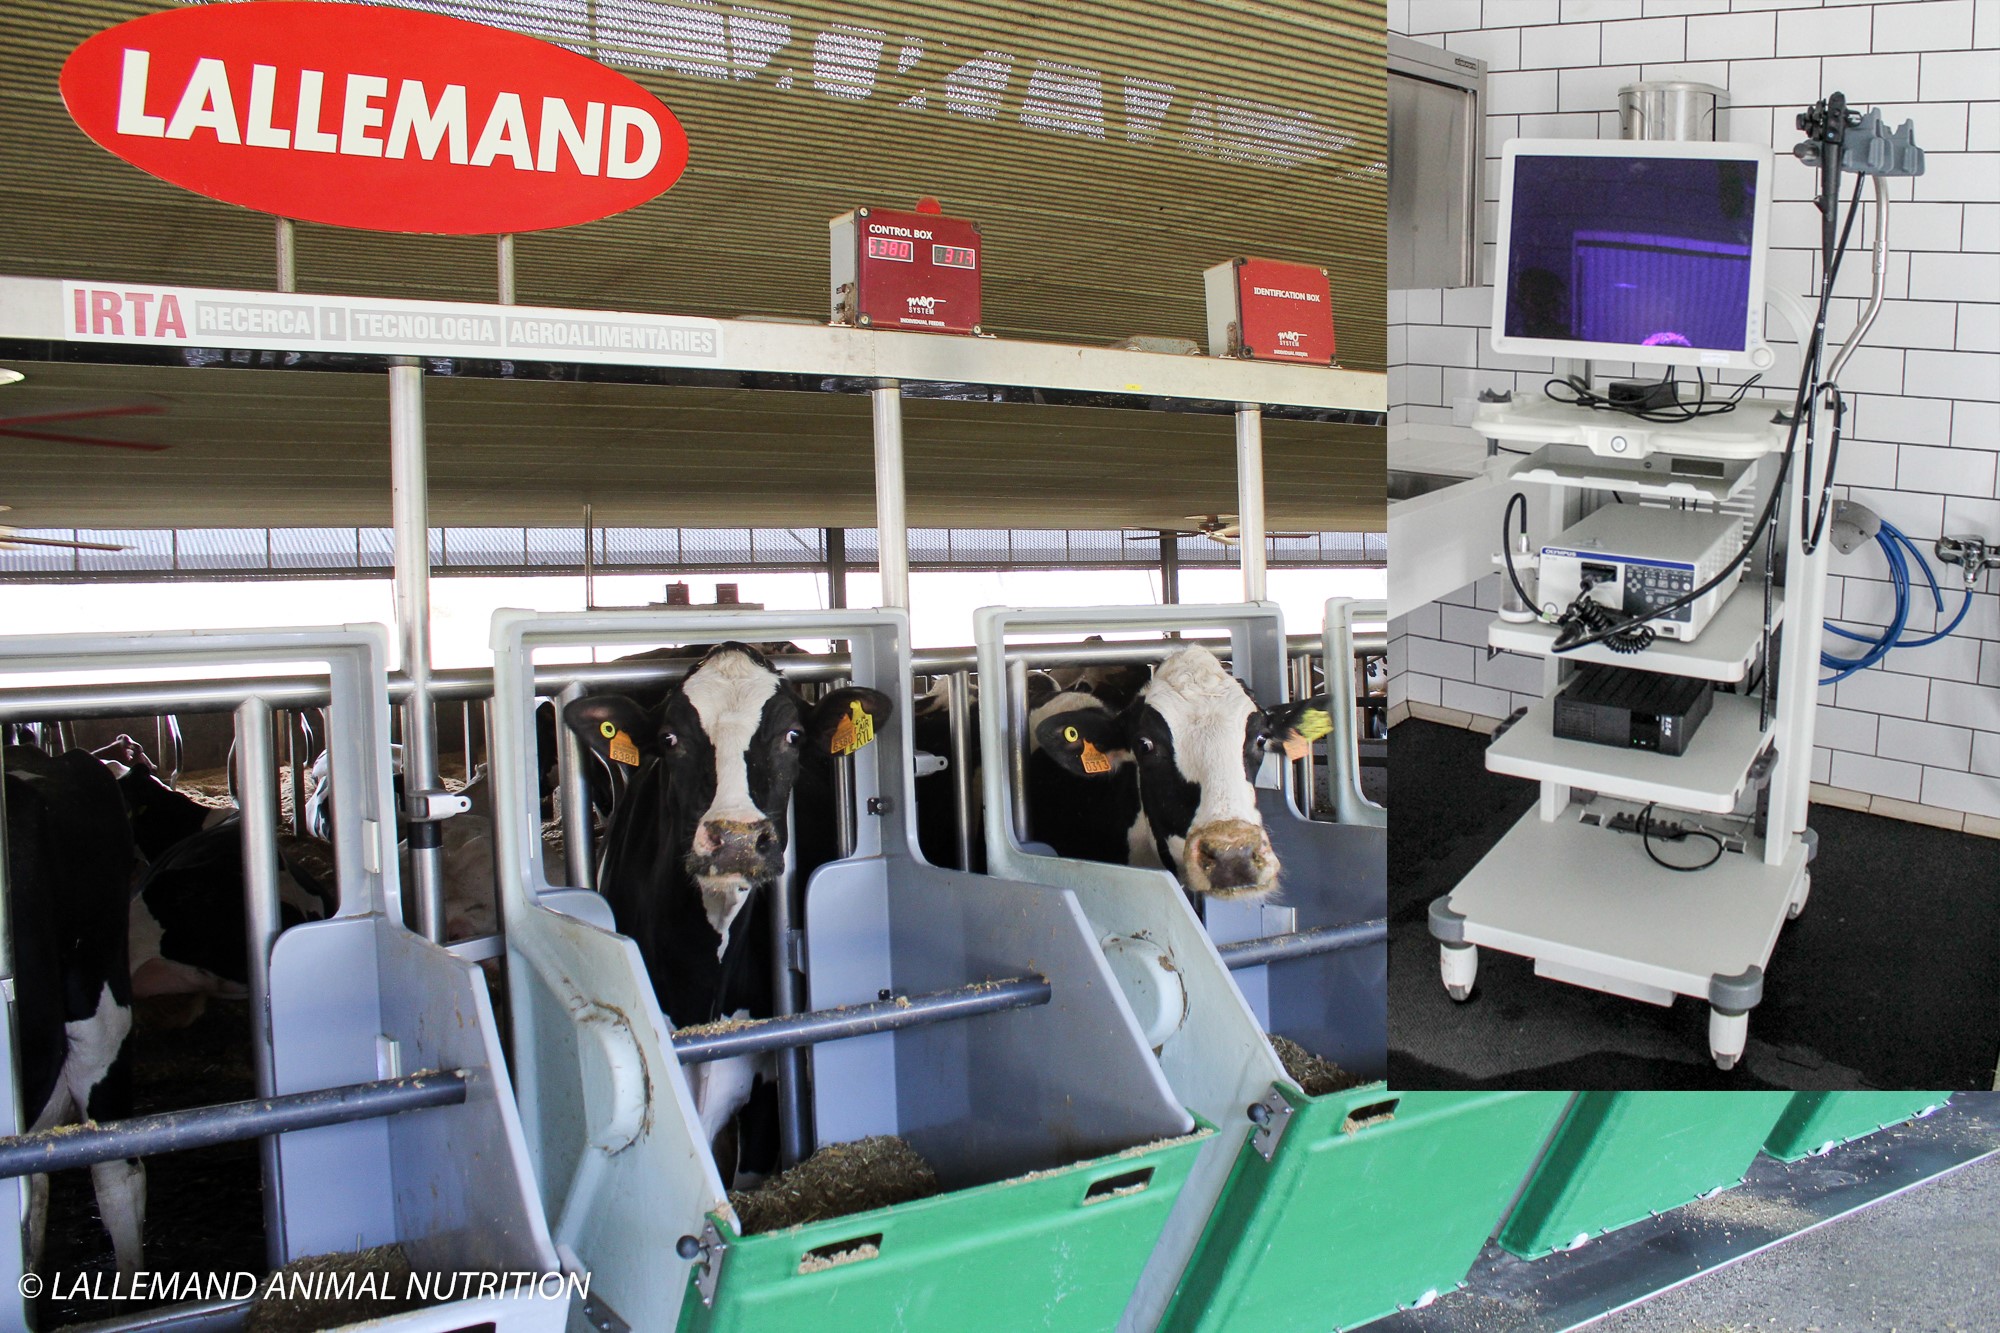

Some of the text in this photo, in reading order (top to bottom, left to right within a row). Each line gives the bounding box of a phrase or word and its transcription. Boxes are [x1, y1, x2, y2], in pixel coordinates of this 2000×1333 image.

[116, 47, 662, 181] LALLEMAND
[868, 223, 933, 241] CONTROL BOX
[1253, 286, 1321, 302] IDENTIFICATION BOX
[908, 307, 935, 315] SYSTEM
[73, 288, 714, 354] IRTA RECERCA I TECNOLOGIA AGROALIMENTÀRIES
[1545, 549, 1577, 558] OLYMPUS
